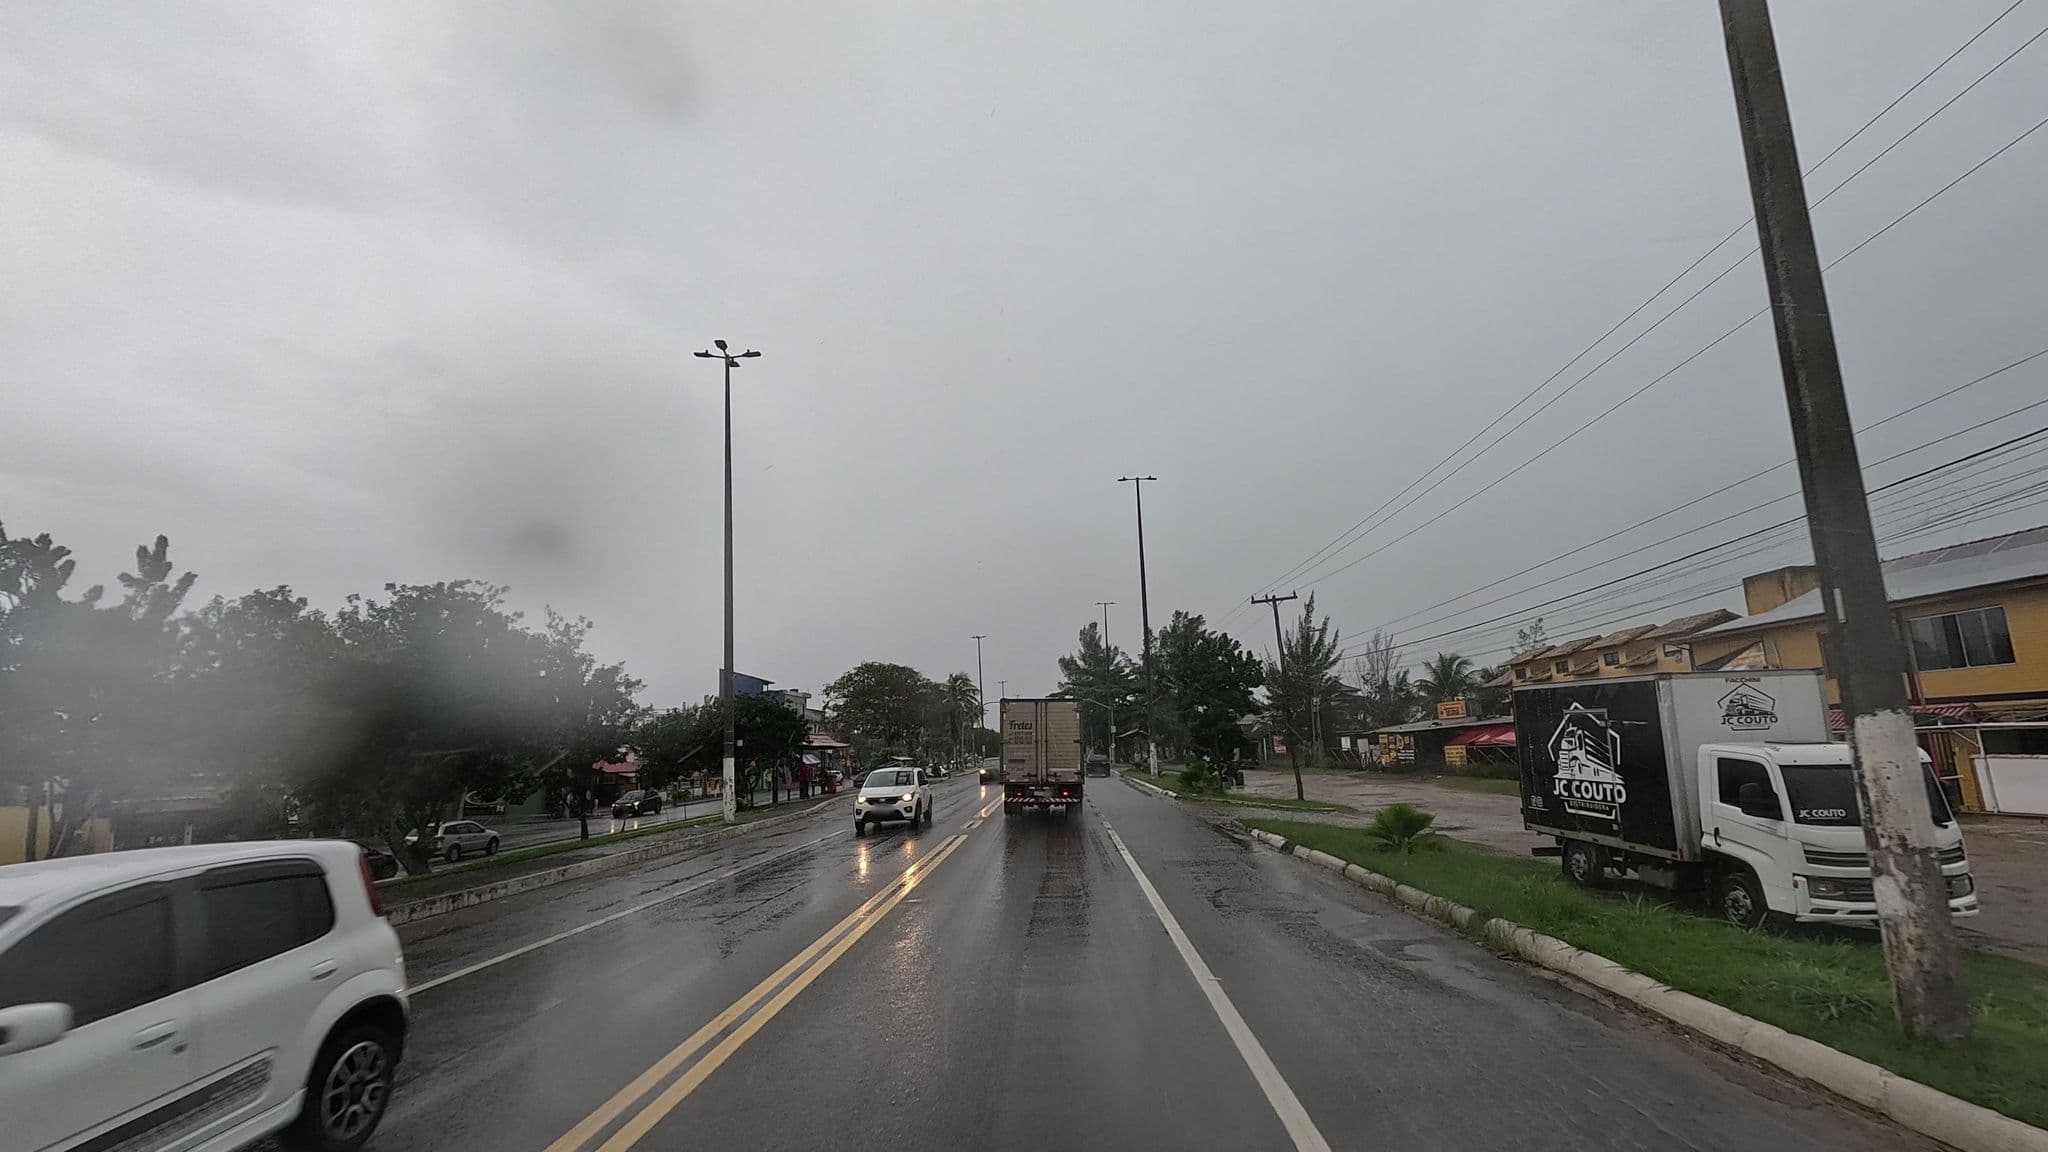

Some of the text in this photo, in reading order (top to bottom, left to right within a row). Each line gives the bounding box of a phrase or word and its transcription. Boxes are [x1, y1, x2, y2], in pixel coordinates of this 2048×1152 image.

[1720, 715, 1778, 725] JC COUTO
[1553, 779, 1627, 804] JC COUTO
[1799, 809, 1811, 818] JC
[1811, 808, 1846, 817] COUTO
